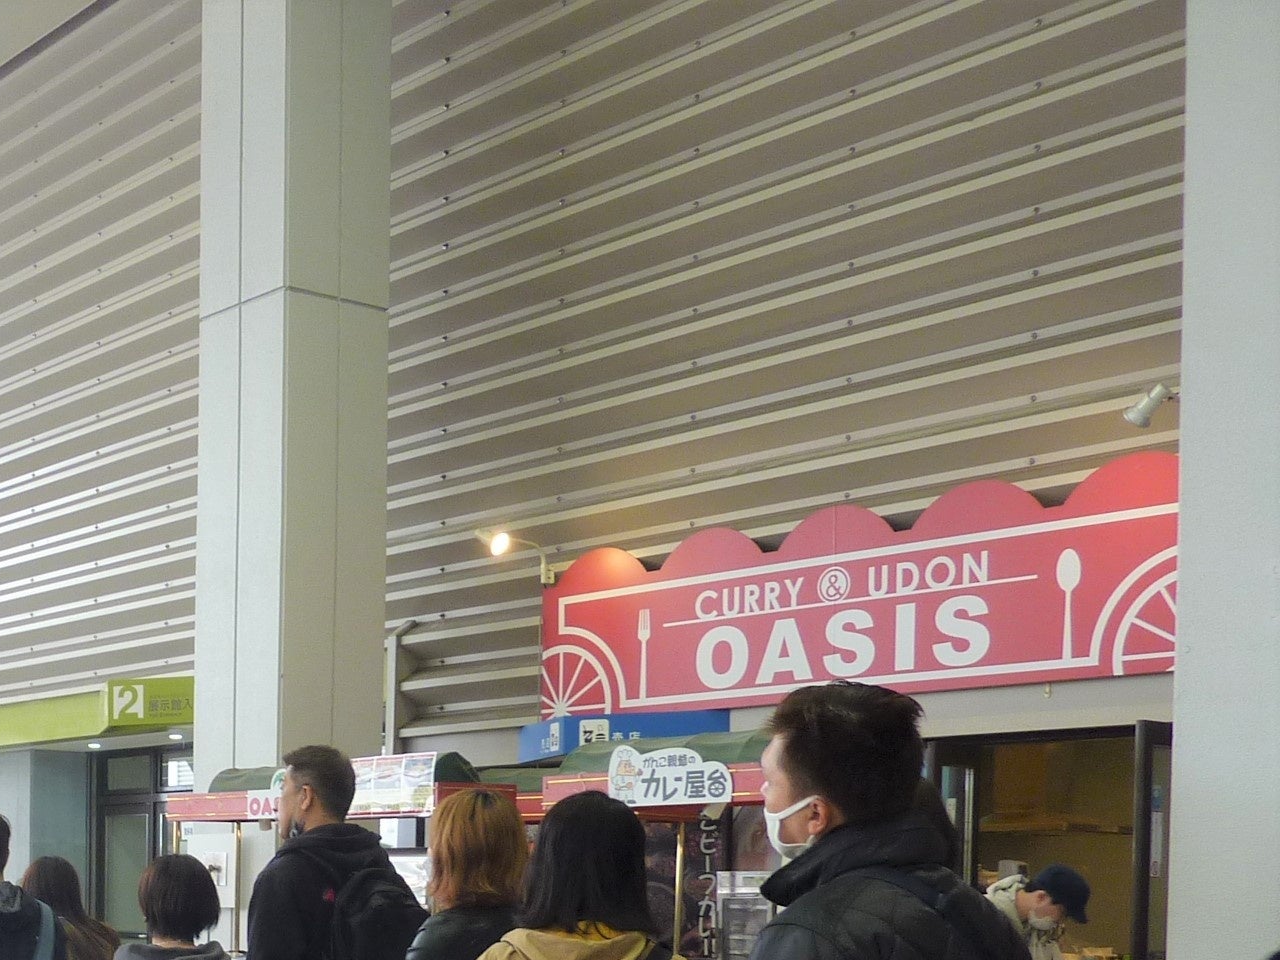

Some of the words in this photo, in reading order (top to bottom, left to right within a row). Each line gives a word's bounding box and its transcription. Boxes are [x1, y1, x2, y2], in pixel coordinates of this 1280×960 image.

[695, 576, 804, 620] CURRY
[868, 550, 990, 597] UDON
[696, 595, 990, 689] OASIS
[116, 684, 141, 719] 2
[148, 698, 193, 712] 展示館入
[641, 768, 727, 801] カレー屋台
[249, 797, 280, 816] OAS
